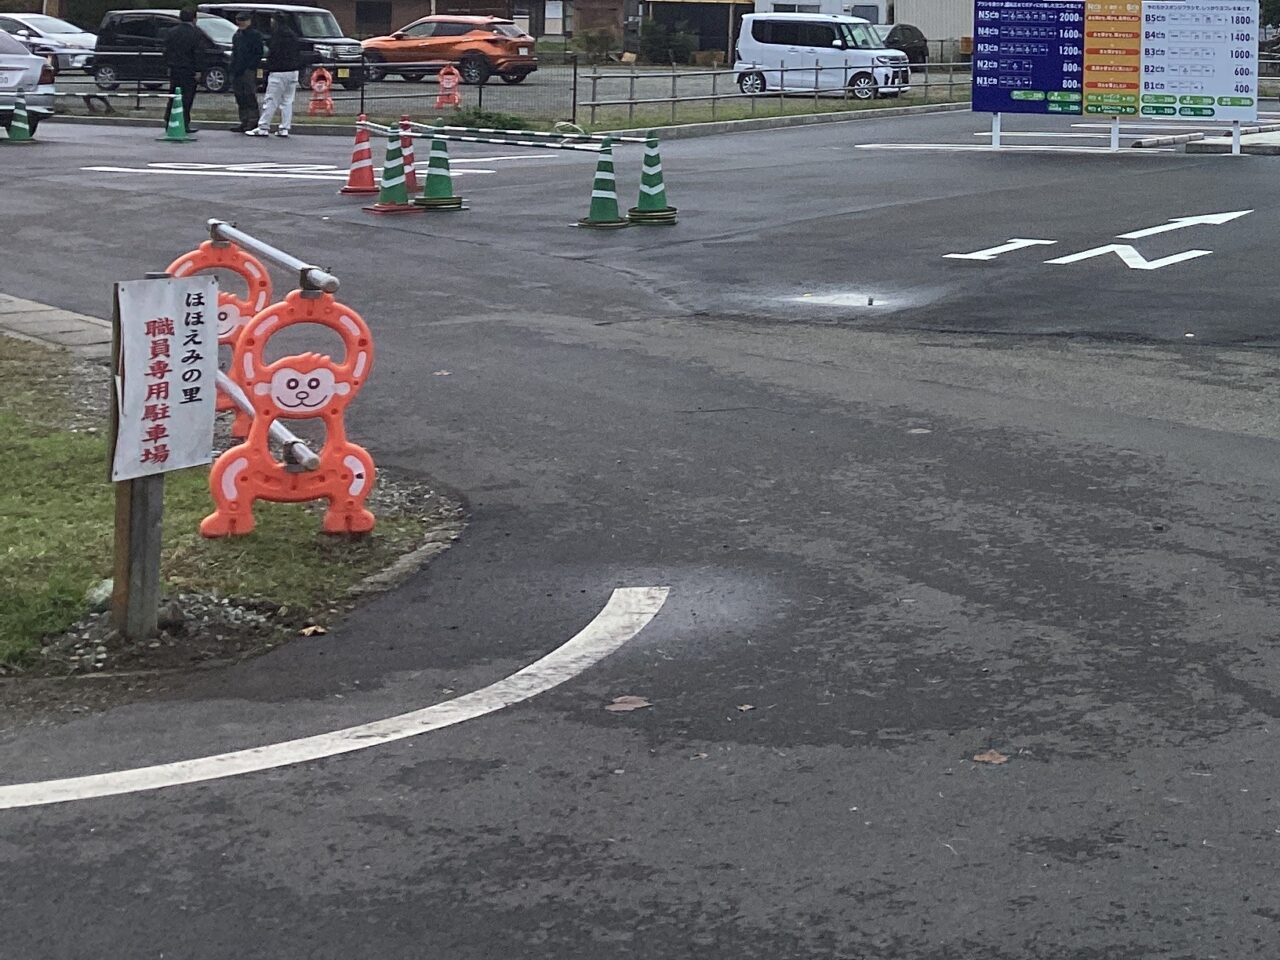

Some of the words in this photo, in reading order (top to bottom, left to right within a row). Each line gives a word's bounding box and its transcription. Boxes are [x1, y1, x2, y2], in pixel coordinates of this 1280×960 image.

[139, 316, 176, 465] 職員専用駐車場
[178, 292, 206, 406] ほほえみの里
